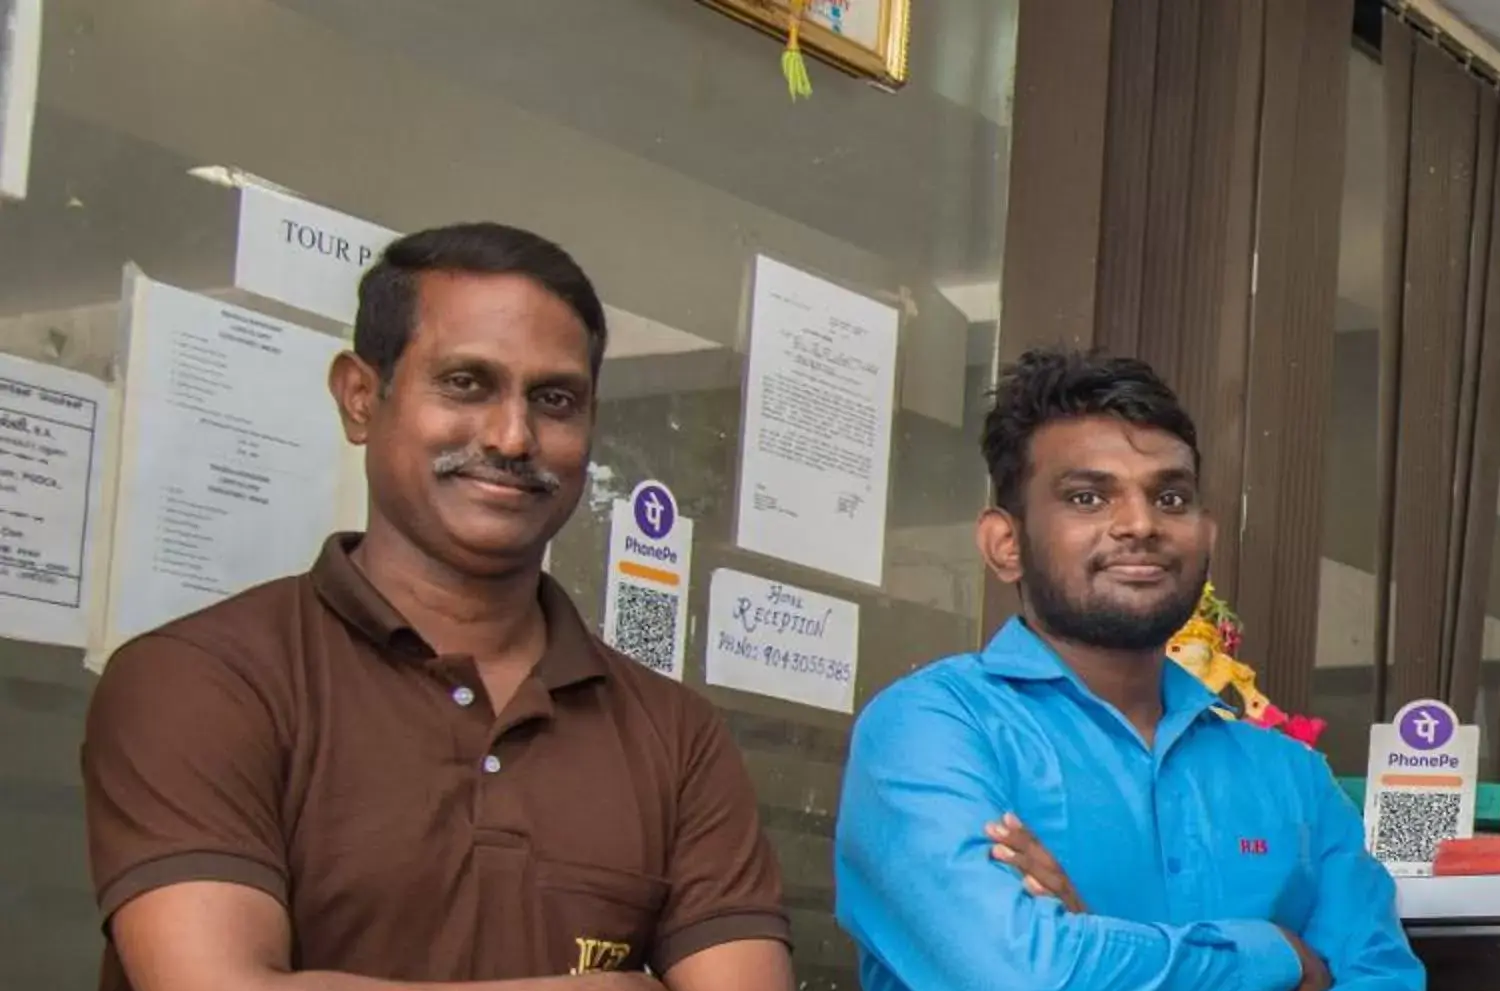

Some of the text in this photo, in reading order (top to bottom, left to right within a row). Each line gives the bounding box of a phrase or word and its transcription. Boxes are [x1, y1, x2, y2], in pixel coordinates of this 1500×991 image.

[281, 218, 373, 267] TOUR P
[625, 535, 678, 565] PhonePe
[732, 597, 833, 638] RECEPTION
[1388, 753, 1460, 769] PhonePe
